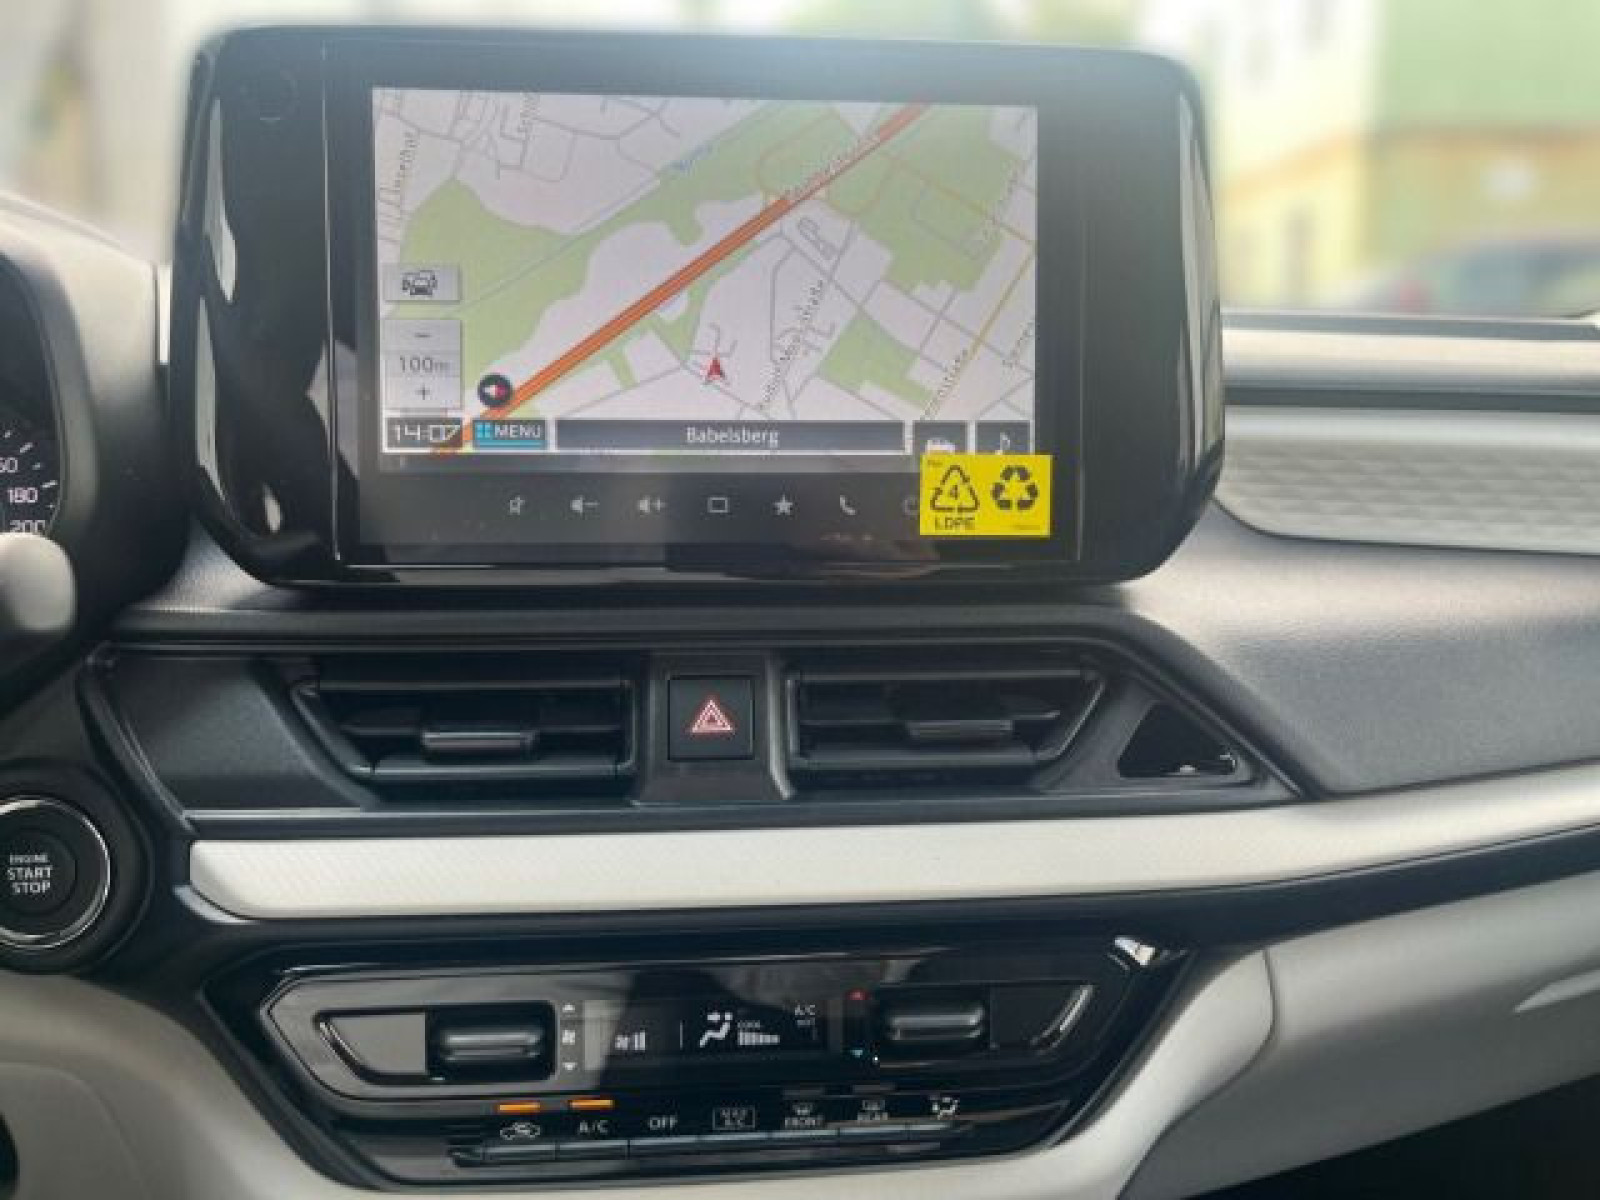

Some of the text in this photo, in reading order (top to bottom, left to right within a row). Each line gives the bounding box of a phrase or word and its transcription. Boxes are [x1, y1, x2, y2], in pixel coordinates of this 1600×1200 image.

[392, 424, 461, 443] 14:07
[494, 425, 541, 439] MENU
[685, 428, 779, 449] Babelsberg
[7, 487, 39, 504] 180
[6, 865, 53, 880] START
[11, 881, 51, 895] STOP
[579, 1120, 609, 1135] A/C
[647, 1114, 678, 1131] OFF
